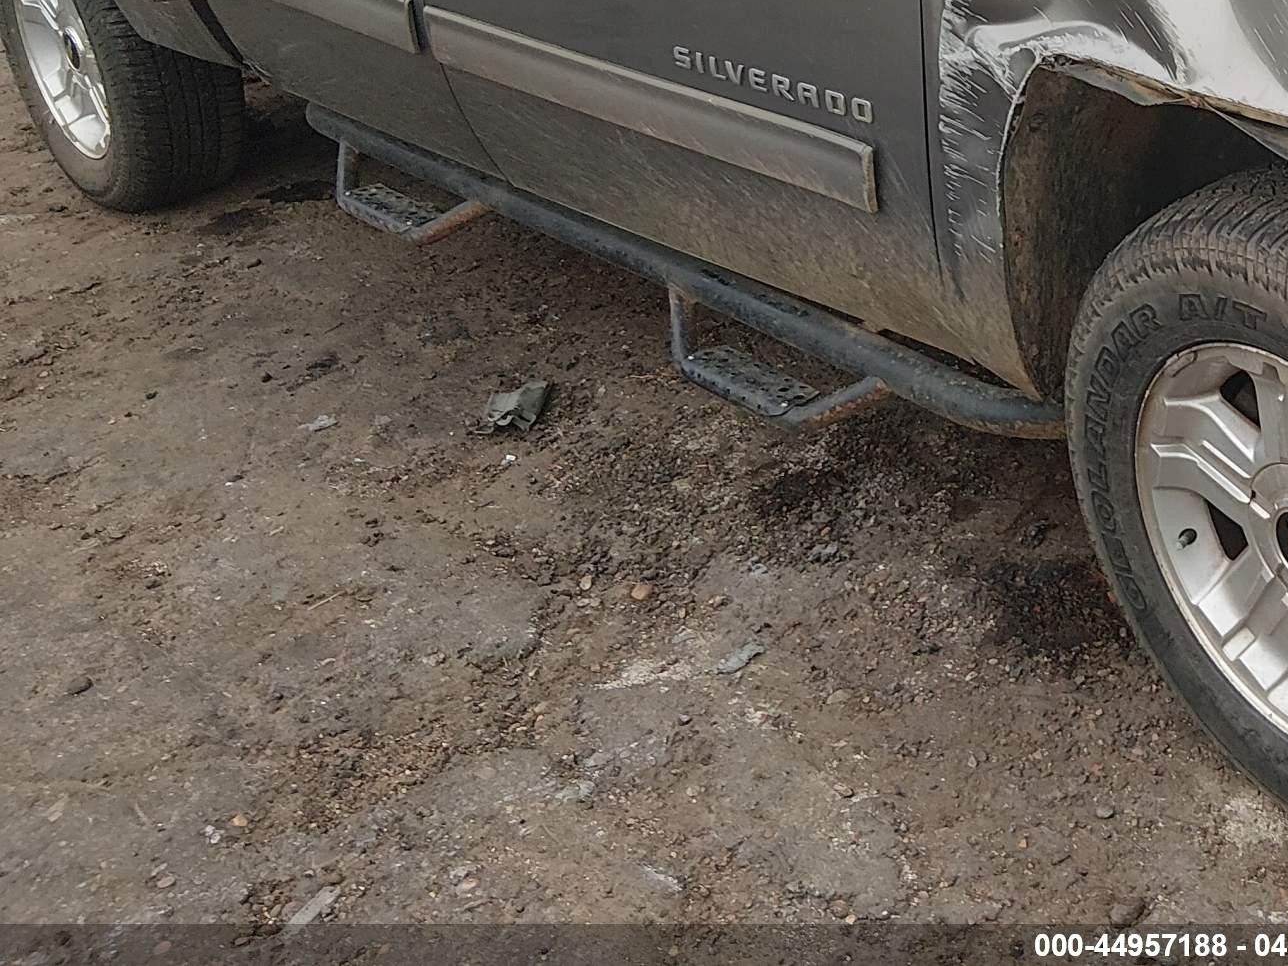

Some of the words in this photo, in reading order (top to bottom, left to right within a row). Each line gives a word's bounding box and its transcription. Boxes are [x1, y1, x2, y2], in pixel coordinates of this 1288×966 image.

[673, 46, 874, 124] SILVERADO
[1084, 302, 1162, 611] GEOLANDAR
[1179, 293, 1267, 331] A/T
